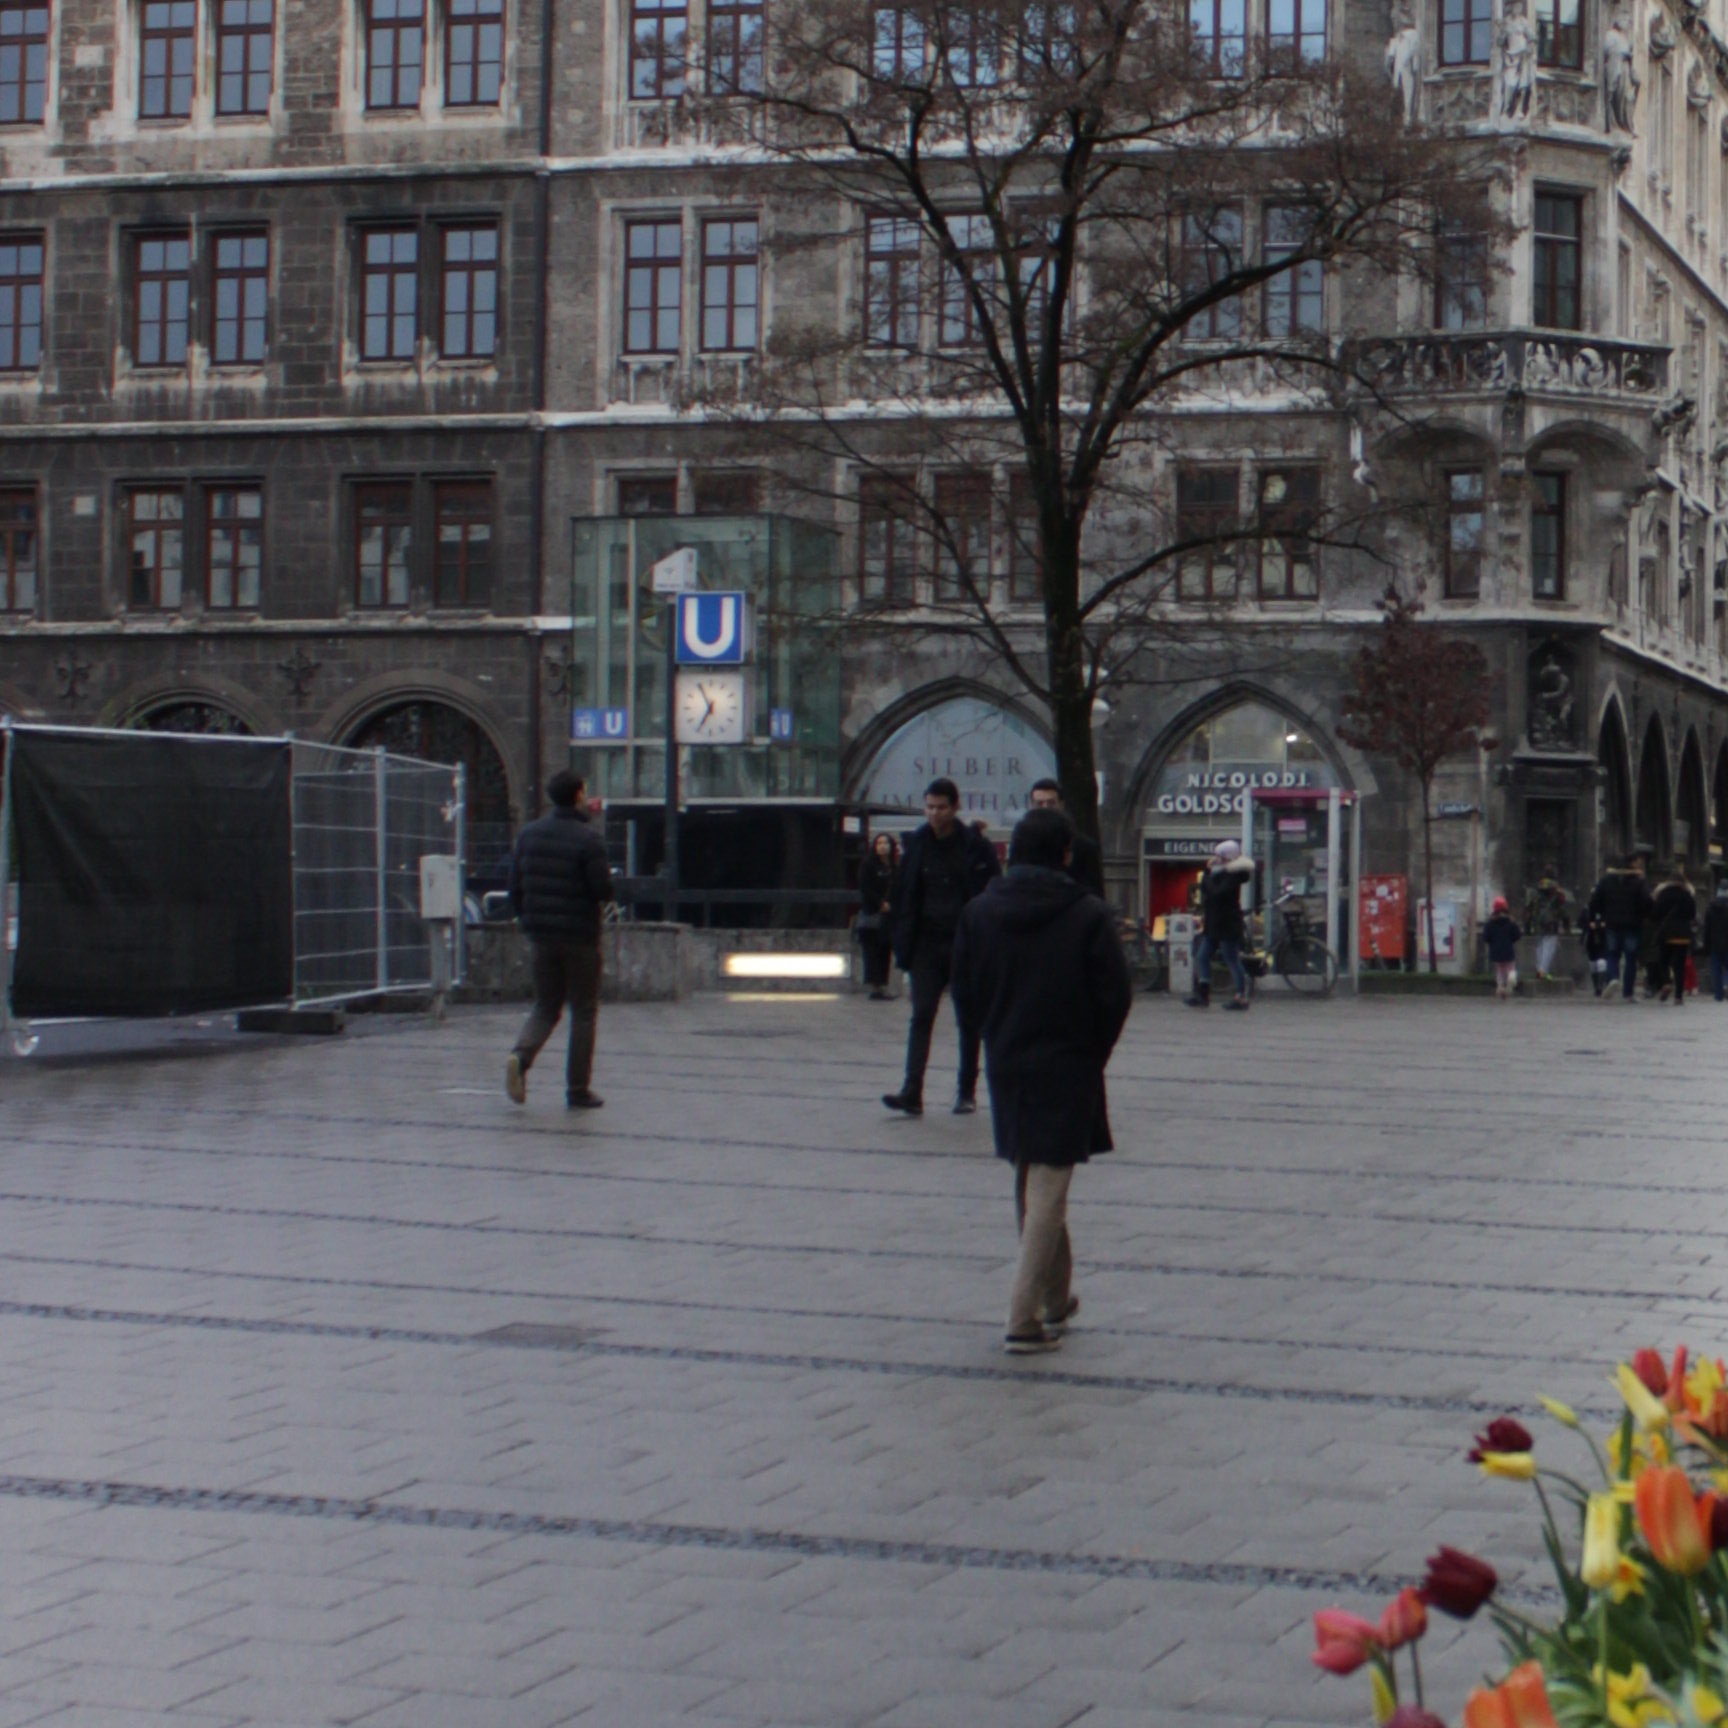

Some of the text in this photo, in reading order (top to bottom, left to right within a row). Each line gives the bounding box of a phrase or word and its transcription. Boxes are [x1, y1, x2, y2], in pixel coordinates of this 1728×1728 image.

[683, 596, 736, 659] U
[604, 711, 623, 735] U
[913, 756, 1022, 776] SILBER
[1187, 771, 1308, 789] NICOLODI
[1157, 793, 1244, 814] GOLDSC
